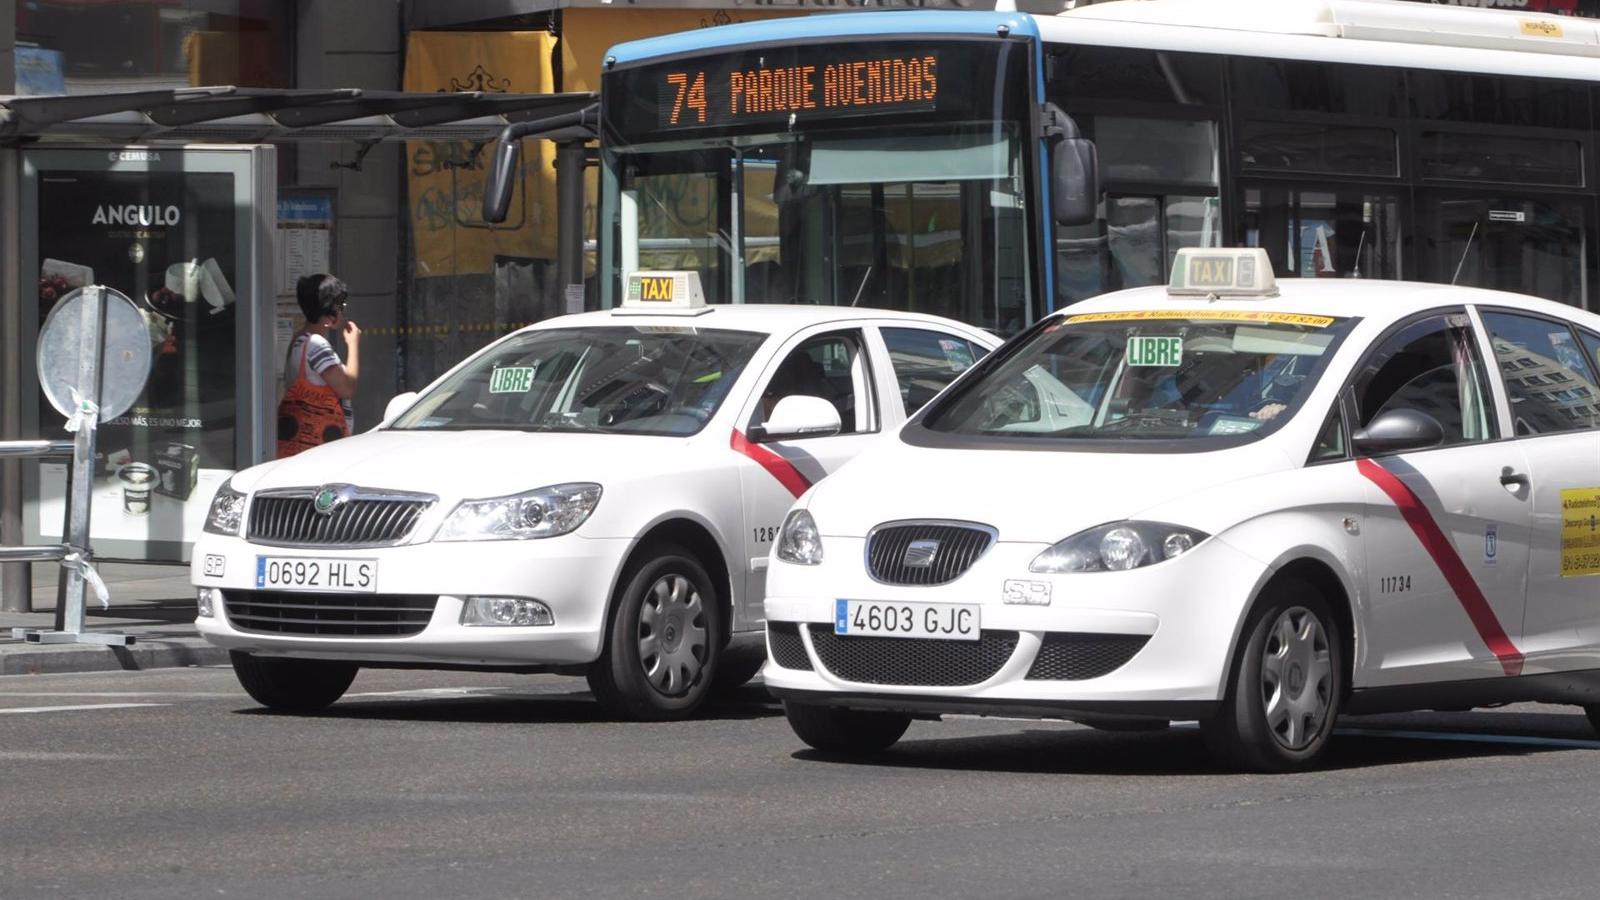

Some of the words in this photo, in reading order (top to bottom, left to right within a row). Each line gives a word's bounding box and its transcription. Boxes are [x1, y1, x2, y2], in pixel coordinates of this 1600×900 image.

[667, 72, 707, 124] 74
[731, 66, 816, 114] PARQUE
[824, 56, 937, 107] AVENIDAS
[119, 152, 161, 161] CEMUSA
[92, 204, 180, 226] ANGULO
[1193, 260, 1233, 283] TAXI
[641, 278, 672, 299] TAXI
[1129, 338, 1180, 364] LIBRE
[492, 368, 532, 391] LIBRE
[207, 557, 223, 573] SP
[269, 561, 320, 585] 0692
[328, 563, 370, 587] HLS
[1010, 583, 1046, 601] SP
[1381, 576, 1411, 593] 11734
[853, 605, 914, 631] 4603
[924, 608, 972, 634] GJC
